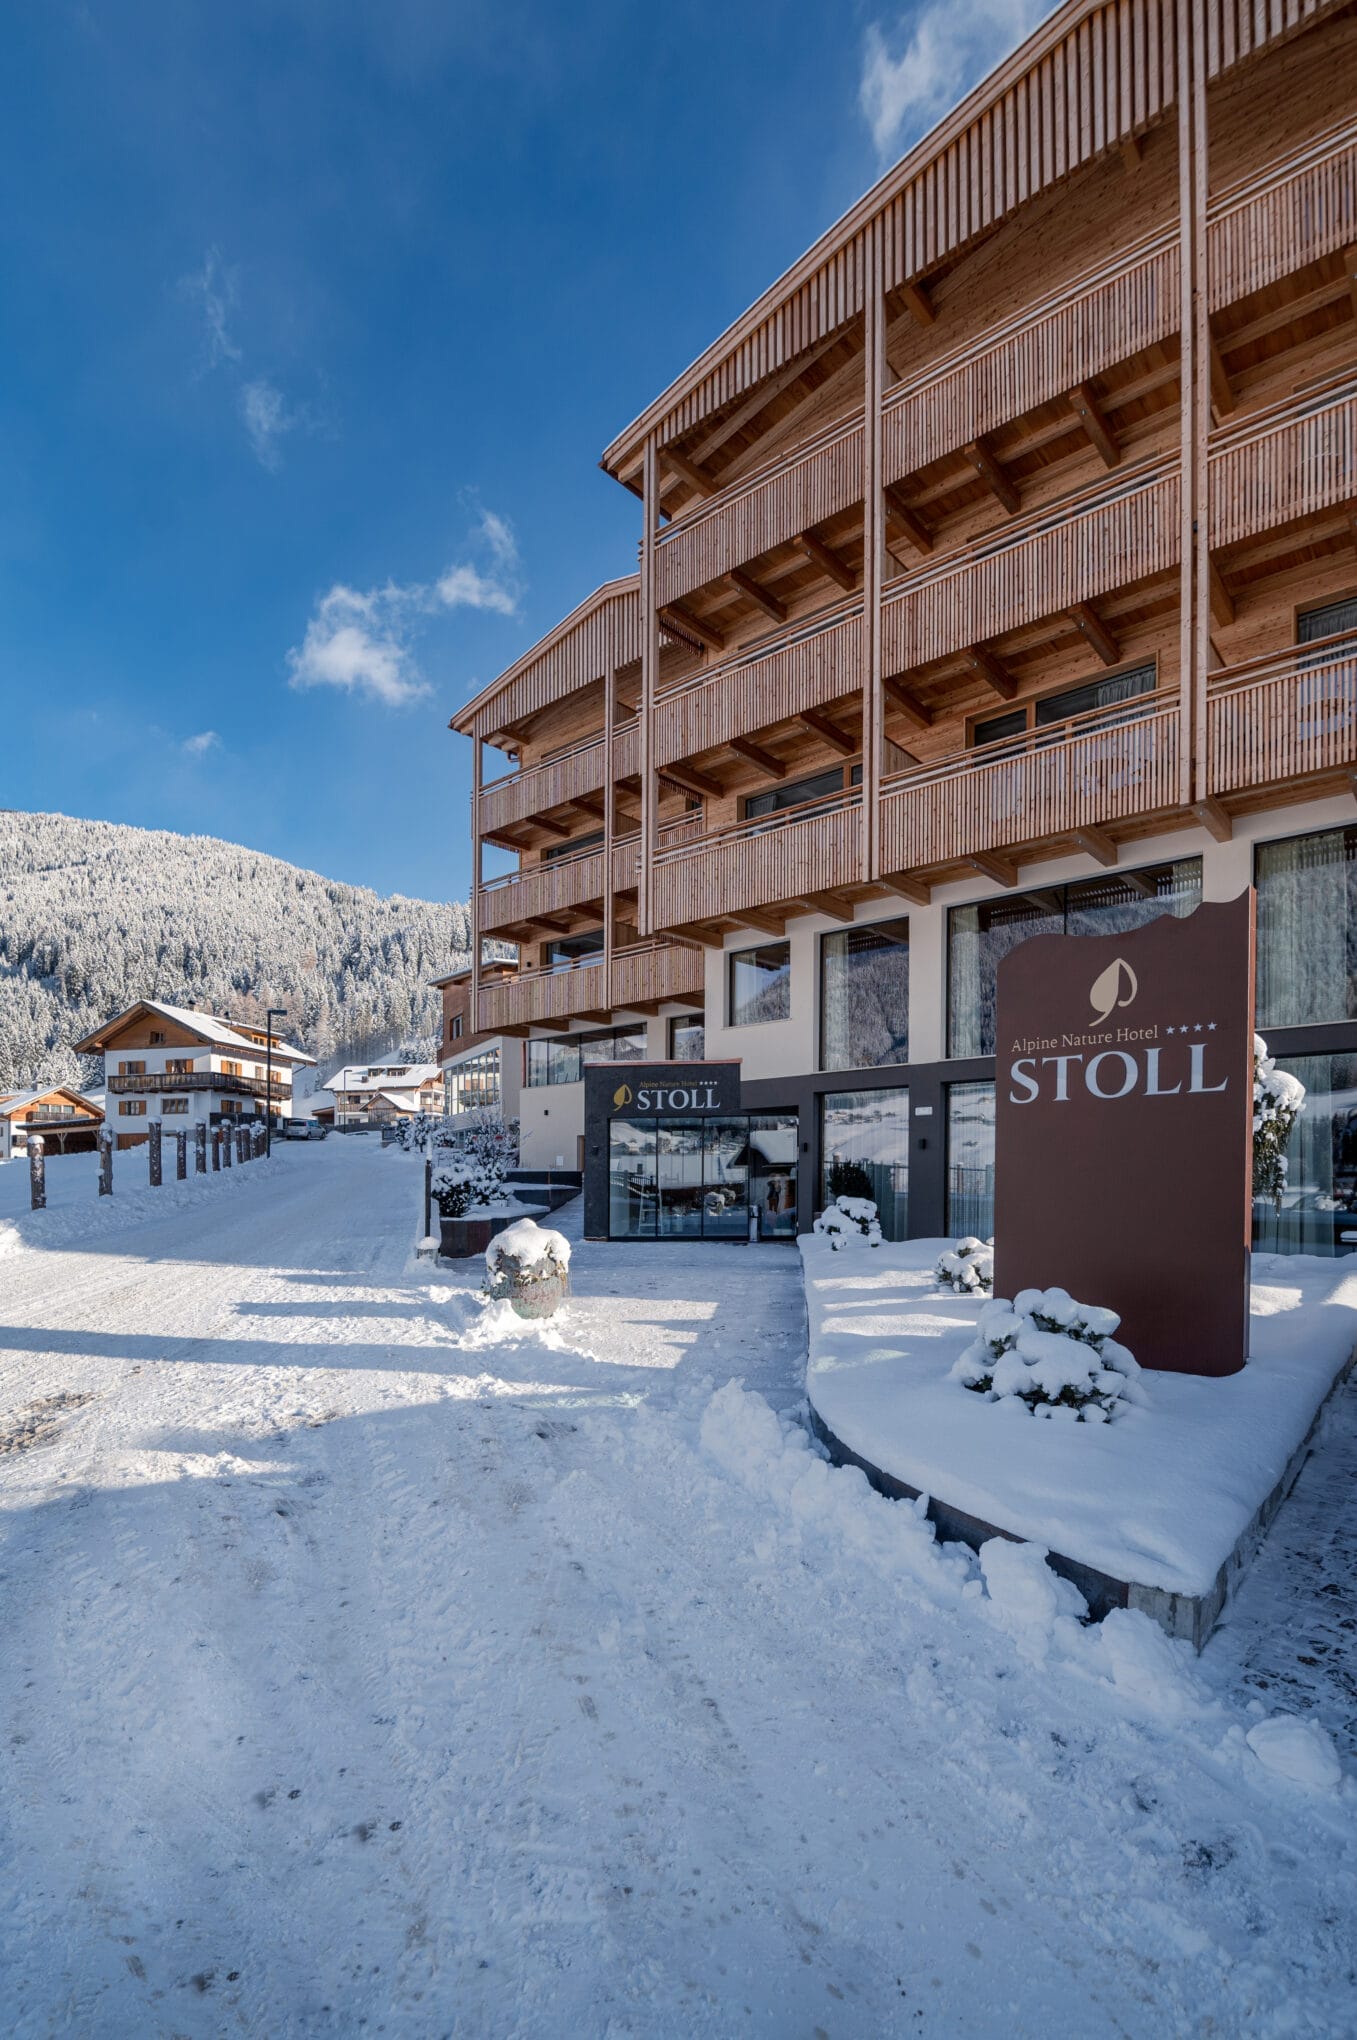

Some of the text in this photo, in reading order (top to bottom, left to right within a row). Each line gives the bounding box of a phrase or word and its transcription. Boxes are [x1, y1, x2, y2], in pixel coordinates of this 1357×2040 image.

[1011, 1025, 1159, 1054] Alpine Nature Hotel
[1009, 1043, 1229, 1104] STOLL
[637, 1089, 721, 1110] STOLL
